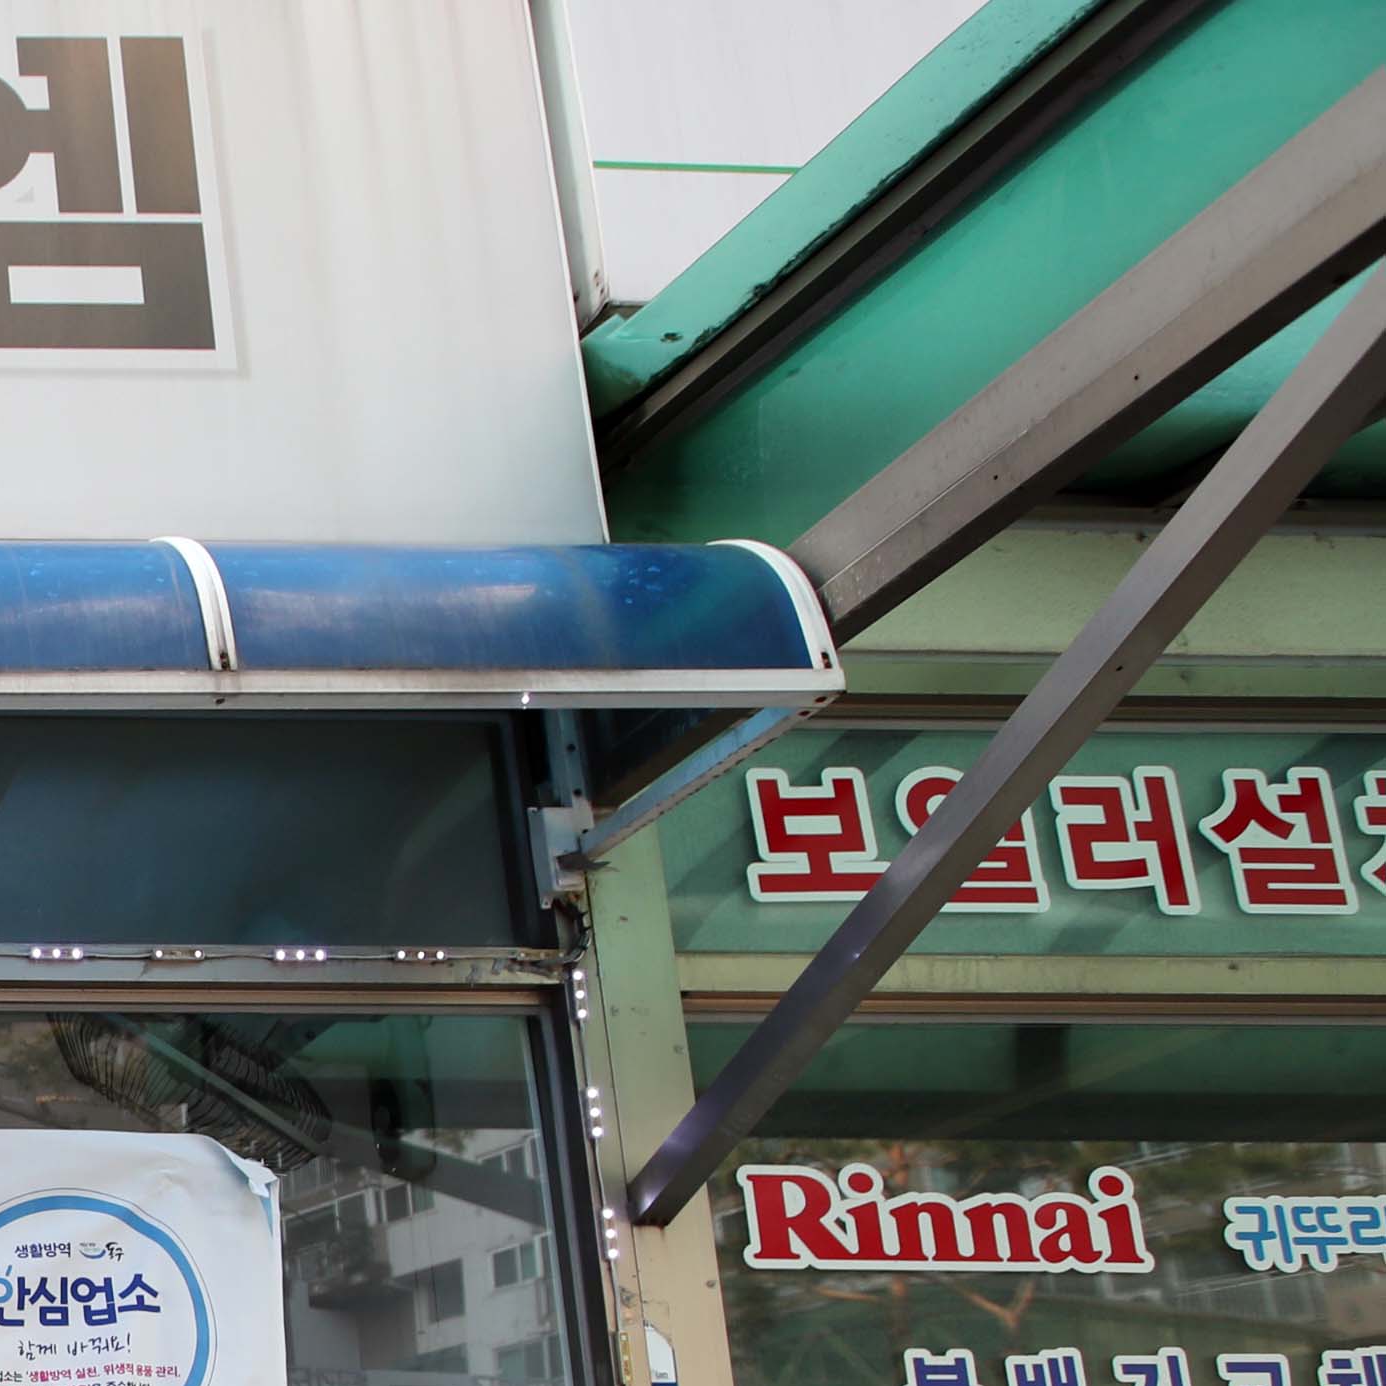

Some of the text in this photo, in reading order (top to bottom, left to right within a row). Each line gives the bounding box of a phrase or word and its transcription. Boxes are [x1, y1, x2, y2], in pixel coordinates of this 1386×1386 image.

[738, 1165, 1153, 1272] Rinnai
[15, 1242, 71, 1259] 생활방역
[17, 1340, 57, 1361] 함께
